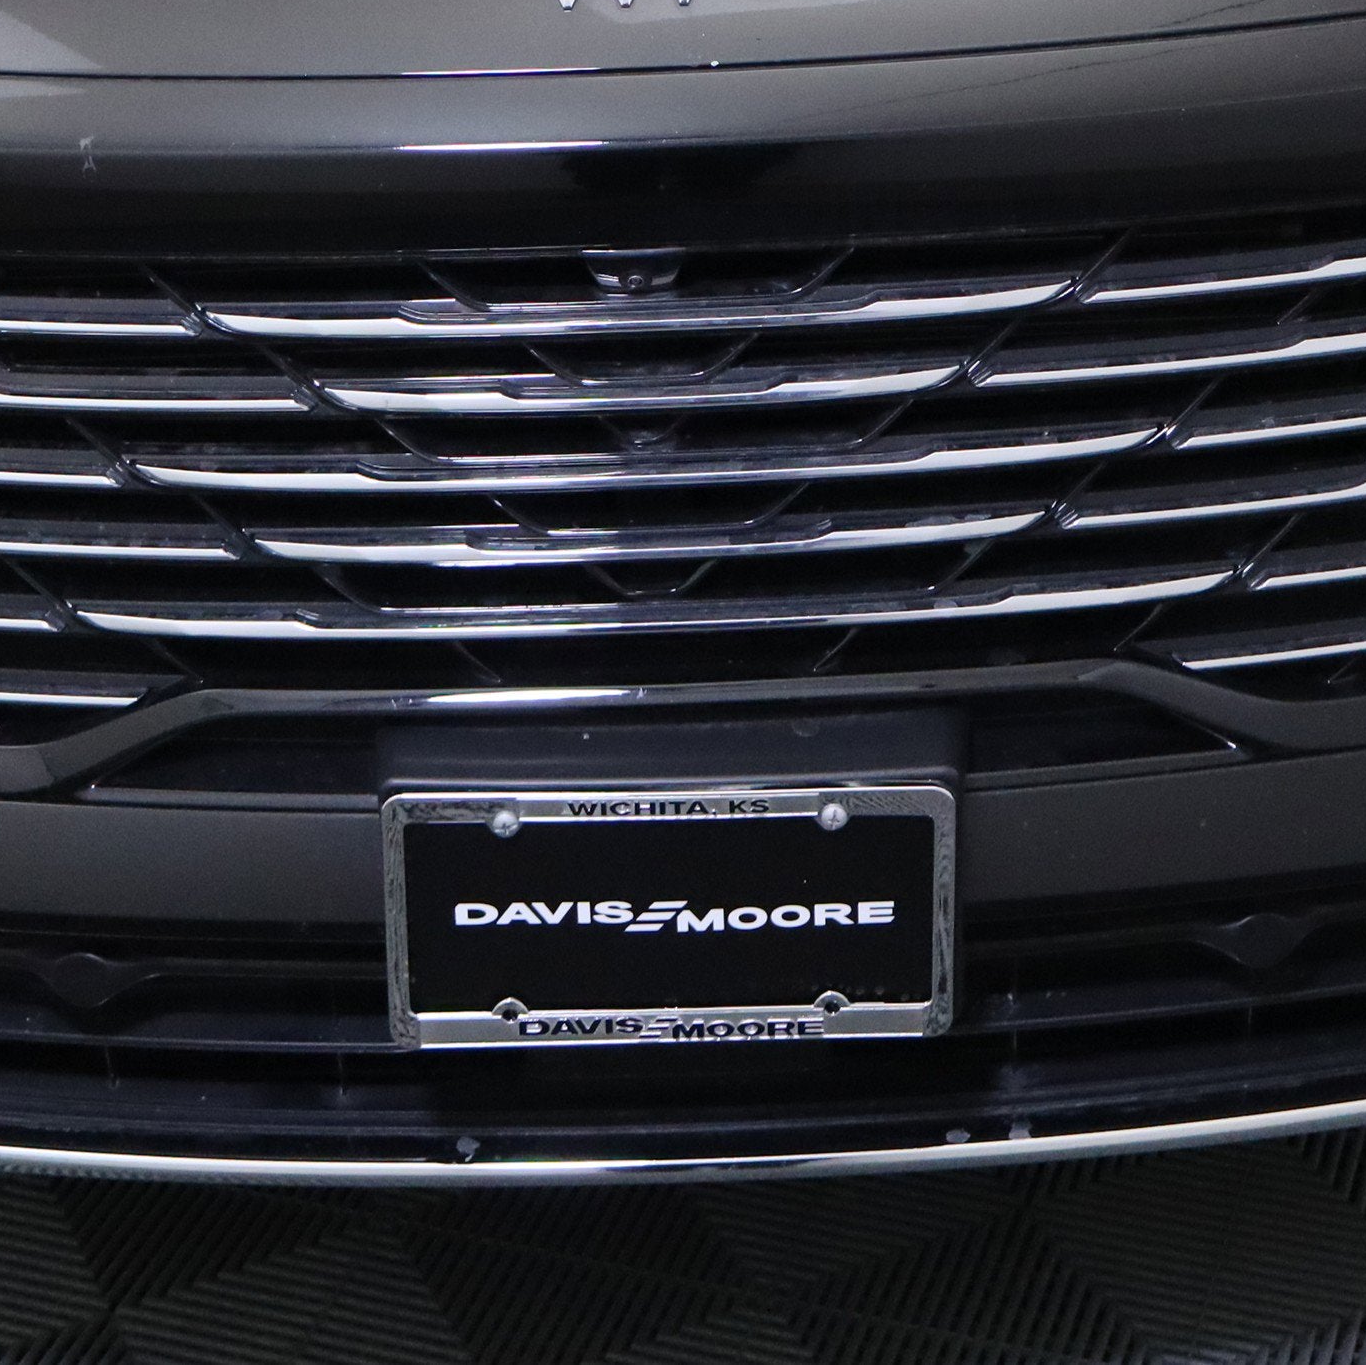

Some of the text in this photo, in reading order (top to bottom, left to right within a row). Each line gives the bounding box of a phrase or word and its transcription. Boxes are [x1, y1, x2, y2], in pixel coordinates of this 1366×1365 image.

[729, 799, 770, 814] KS
[454, 900, 895, 933] DAVIS MOORE
[519, 1017, 824, 1041] DAVIS MOORE
